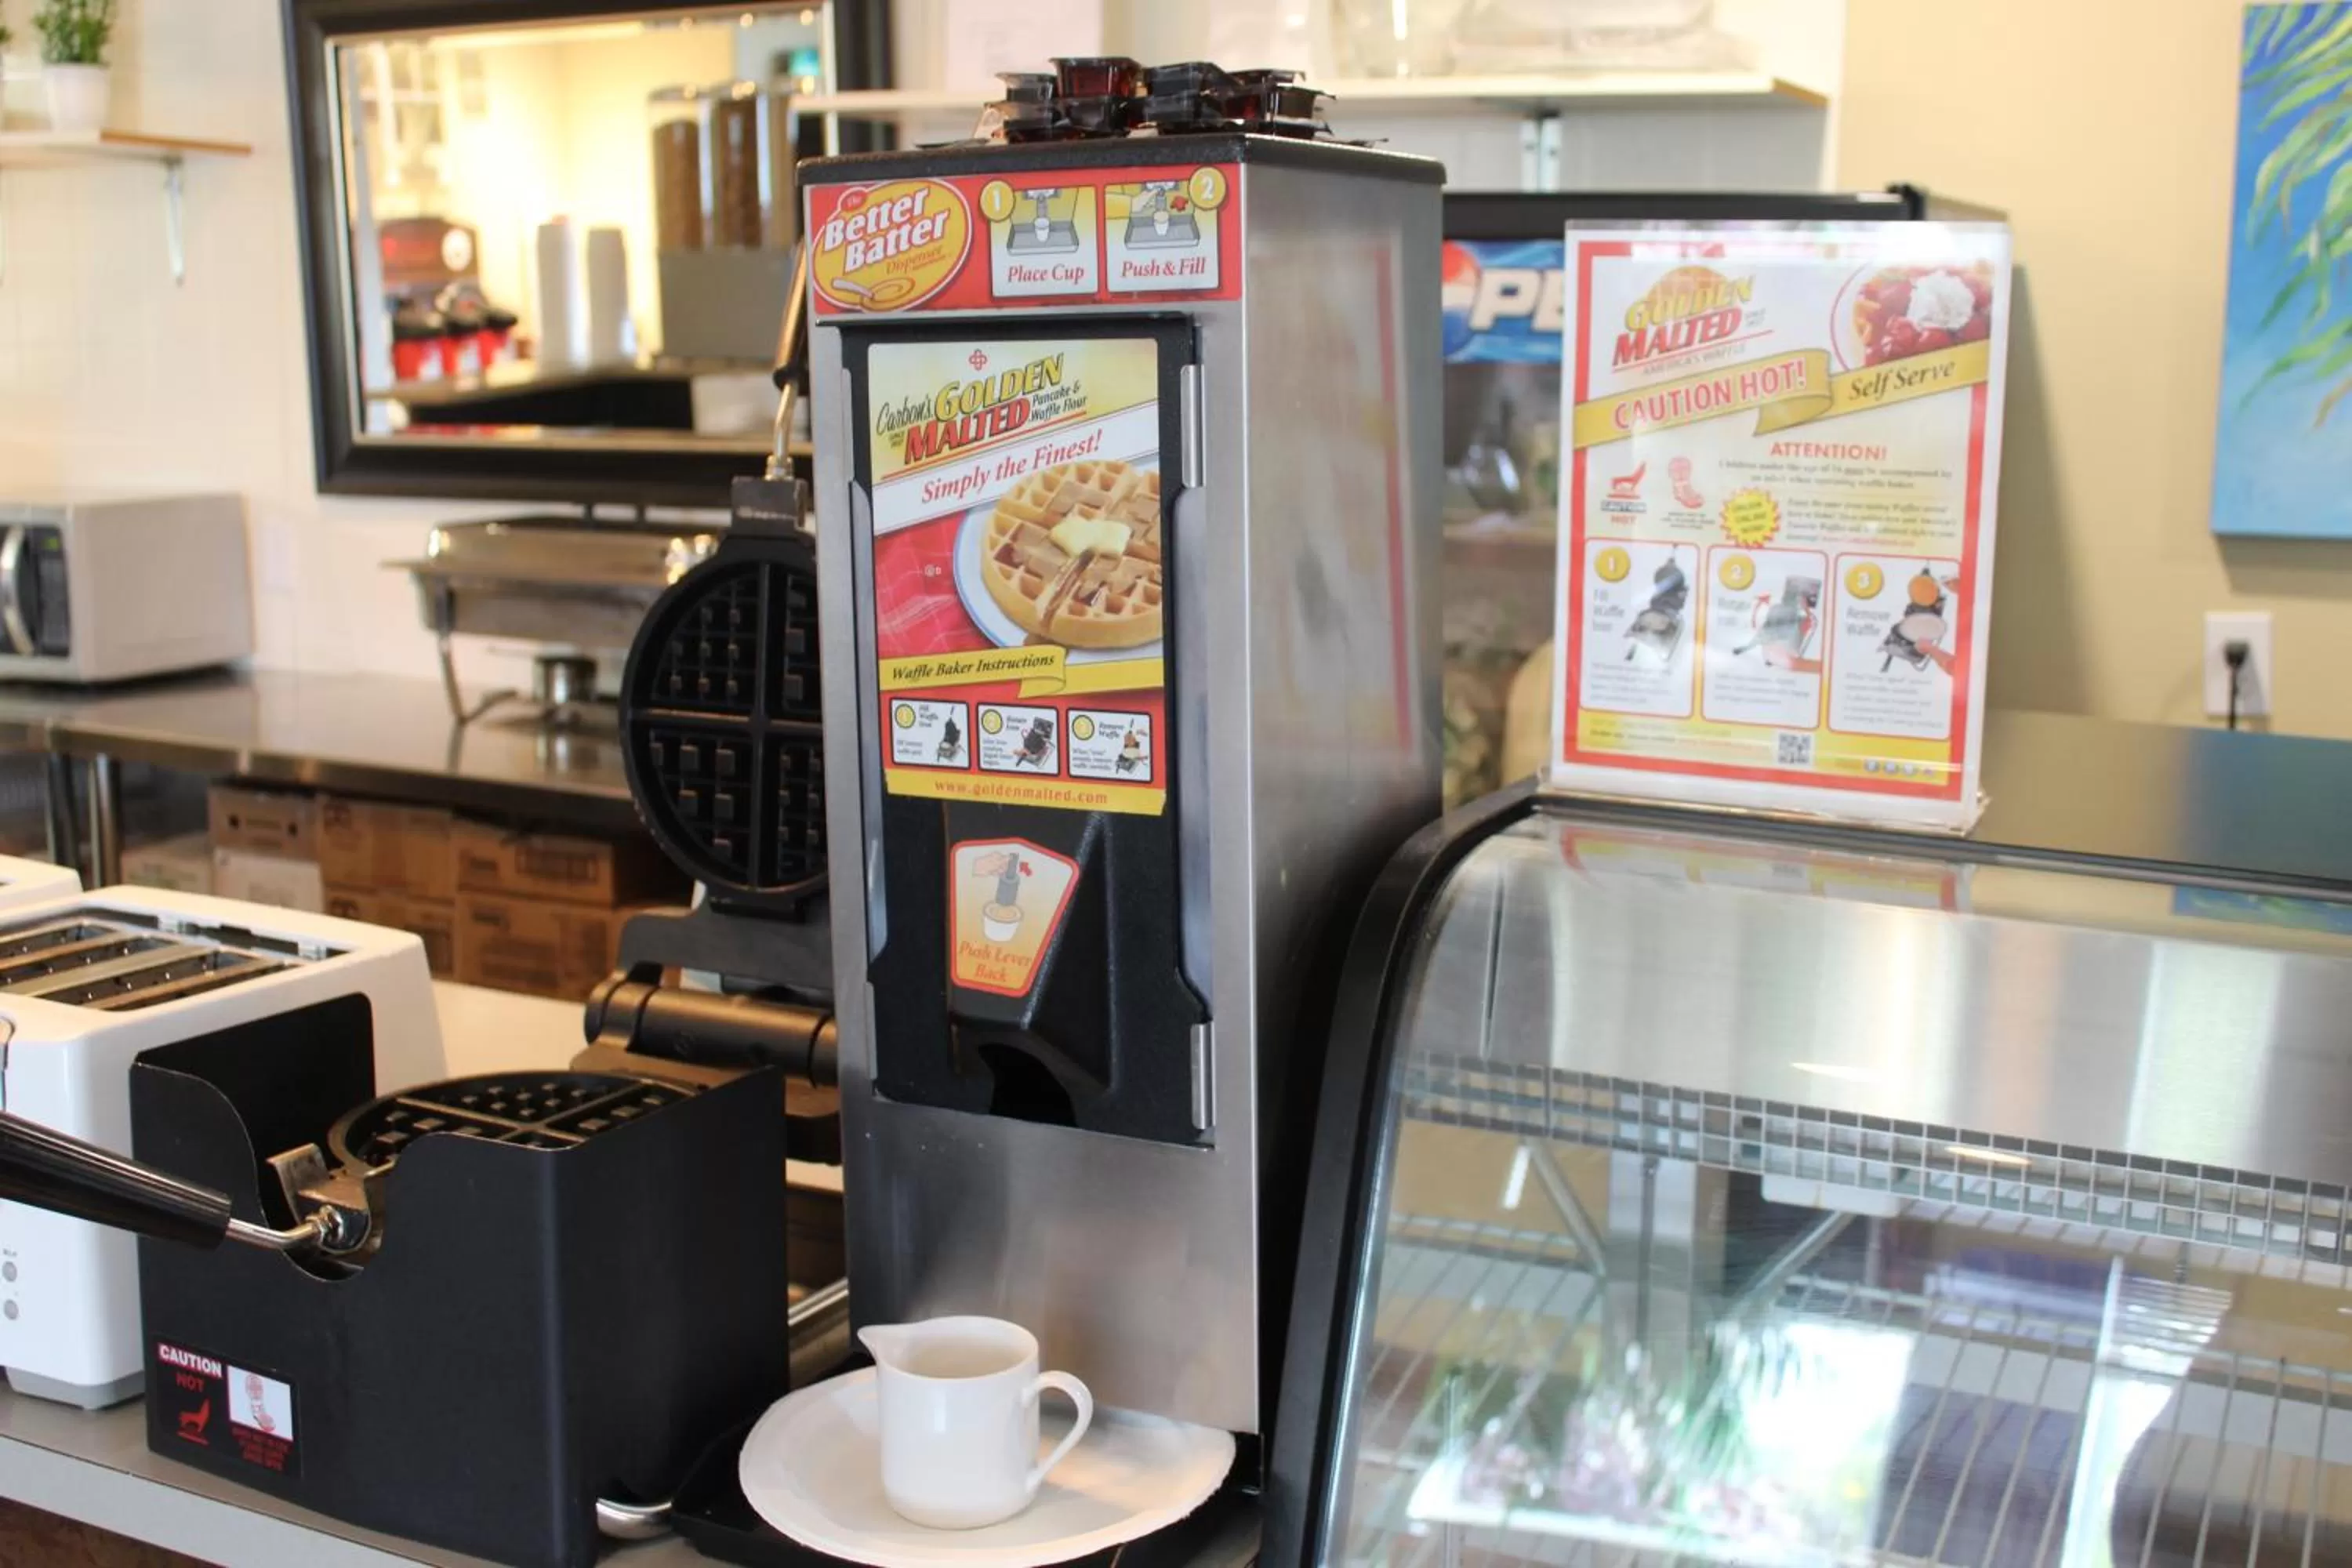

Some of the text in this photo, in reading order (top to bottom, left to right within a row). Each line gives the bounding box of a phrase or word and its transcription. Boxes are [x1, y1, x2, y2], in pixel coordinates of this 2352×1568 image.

[992, 189, 1002, 212] 1
[1200, 176, 1214, 201] 2
[823, 187, 931, 252] Better
[843, 208, 951, 275] Batter
[1007, 263, 1085, 285] Place Cup
[1120, 256, 1207, 278] Push & Fill
[1624, 274, 1756, 332] GOLDEN
[1611, 307, 1744, 366] MALTED
[934, 353, 1064, 422] GOLDEN
[1614, 359, 1807, 430] CAUTION HOT!
[1848, 361, 1956, 402] Self Serve
[1032, 385, 1072, 407] Pancake
[904, 397, 1031, 465] MALTED
[1769, 441, 1888, 460] ATTENTION!
[921, 428, 1103, 505] Simply the Finest!
[1608, 556, 1617, 573] 1
[1730, 564, 1743, 583] 2
[1856, 571, 1872, 590] 3
[891, 652, 1055, 682] Waffle Baker Instructions
[934, 780, 1108, 804] www.goldenmalted.com
[959, 939, 1033, 967] Push Lever
[975, 962, 1007, 982] Back
[158, 1344, 223, 1380] CAUTION
[175, 1372, 205, 1394] HOT
